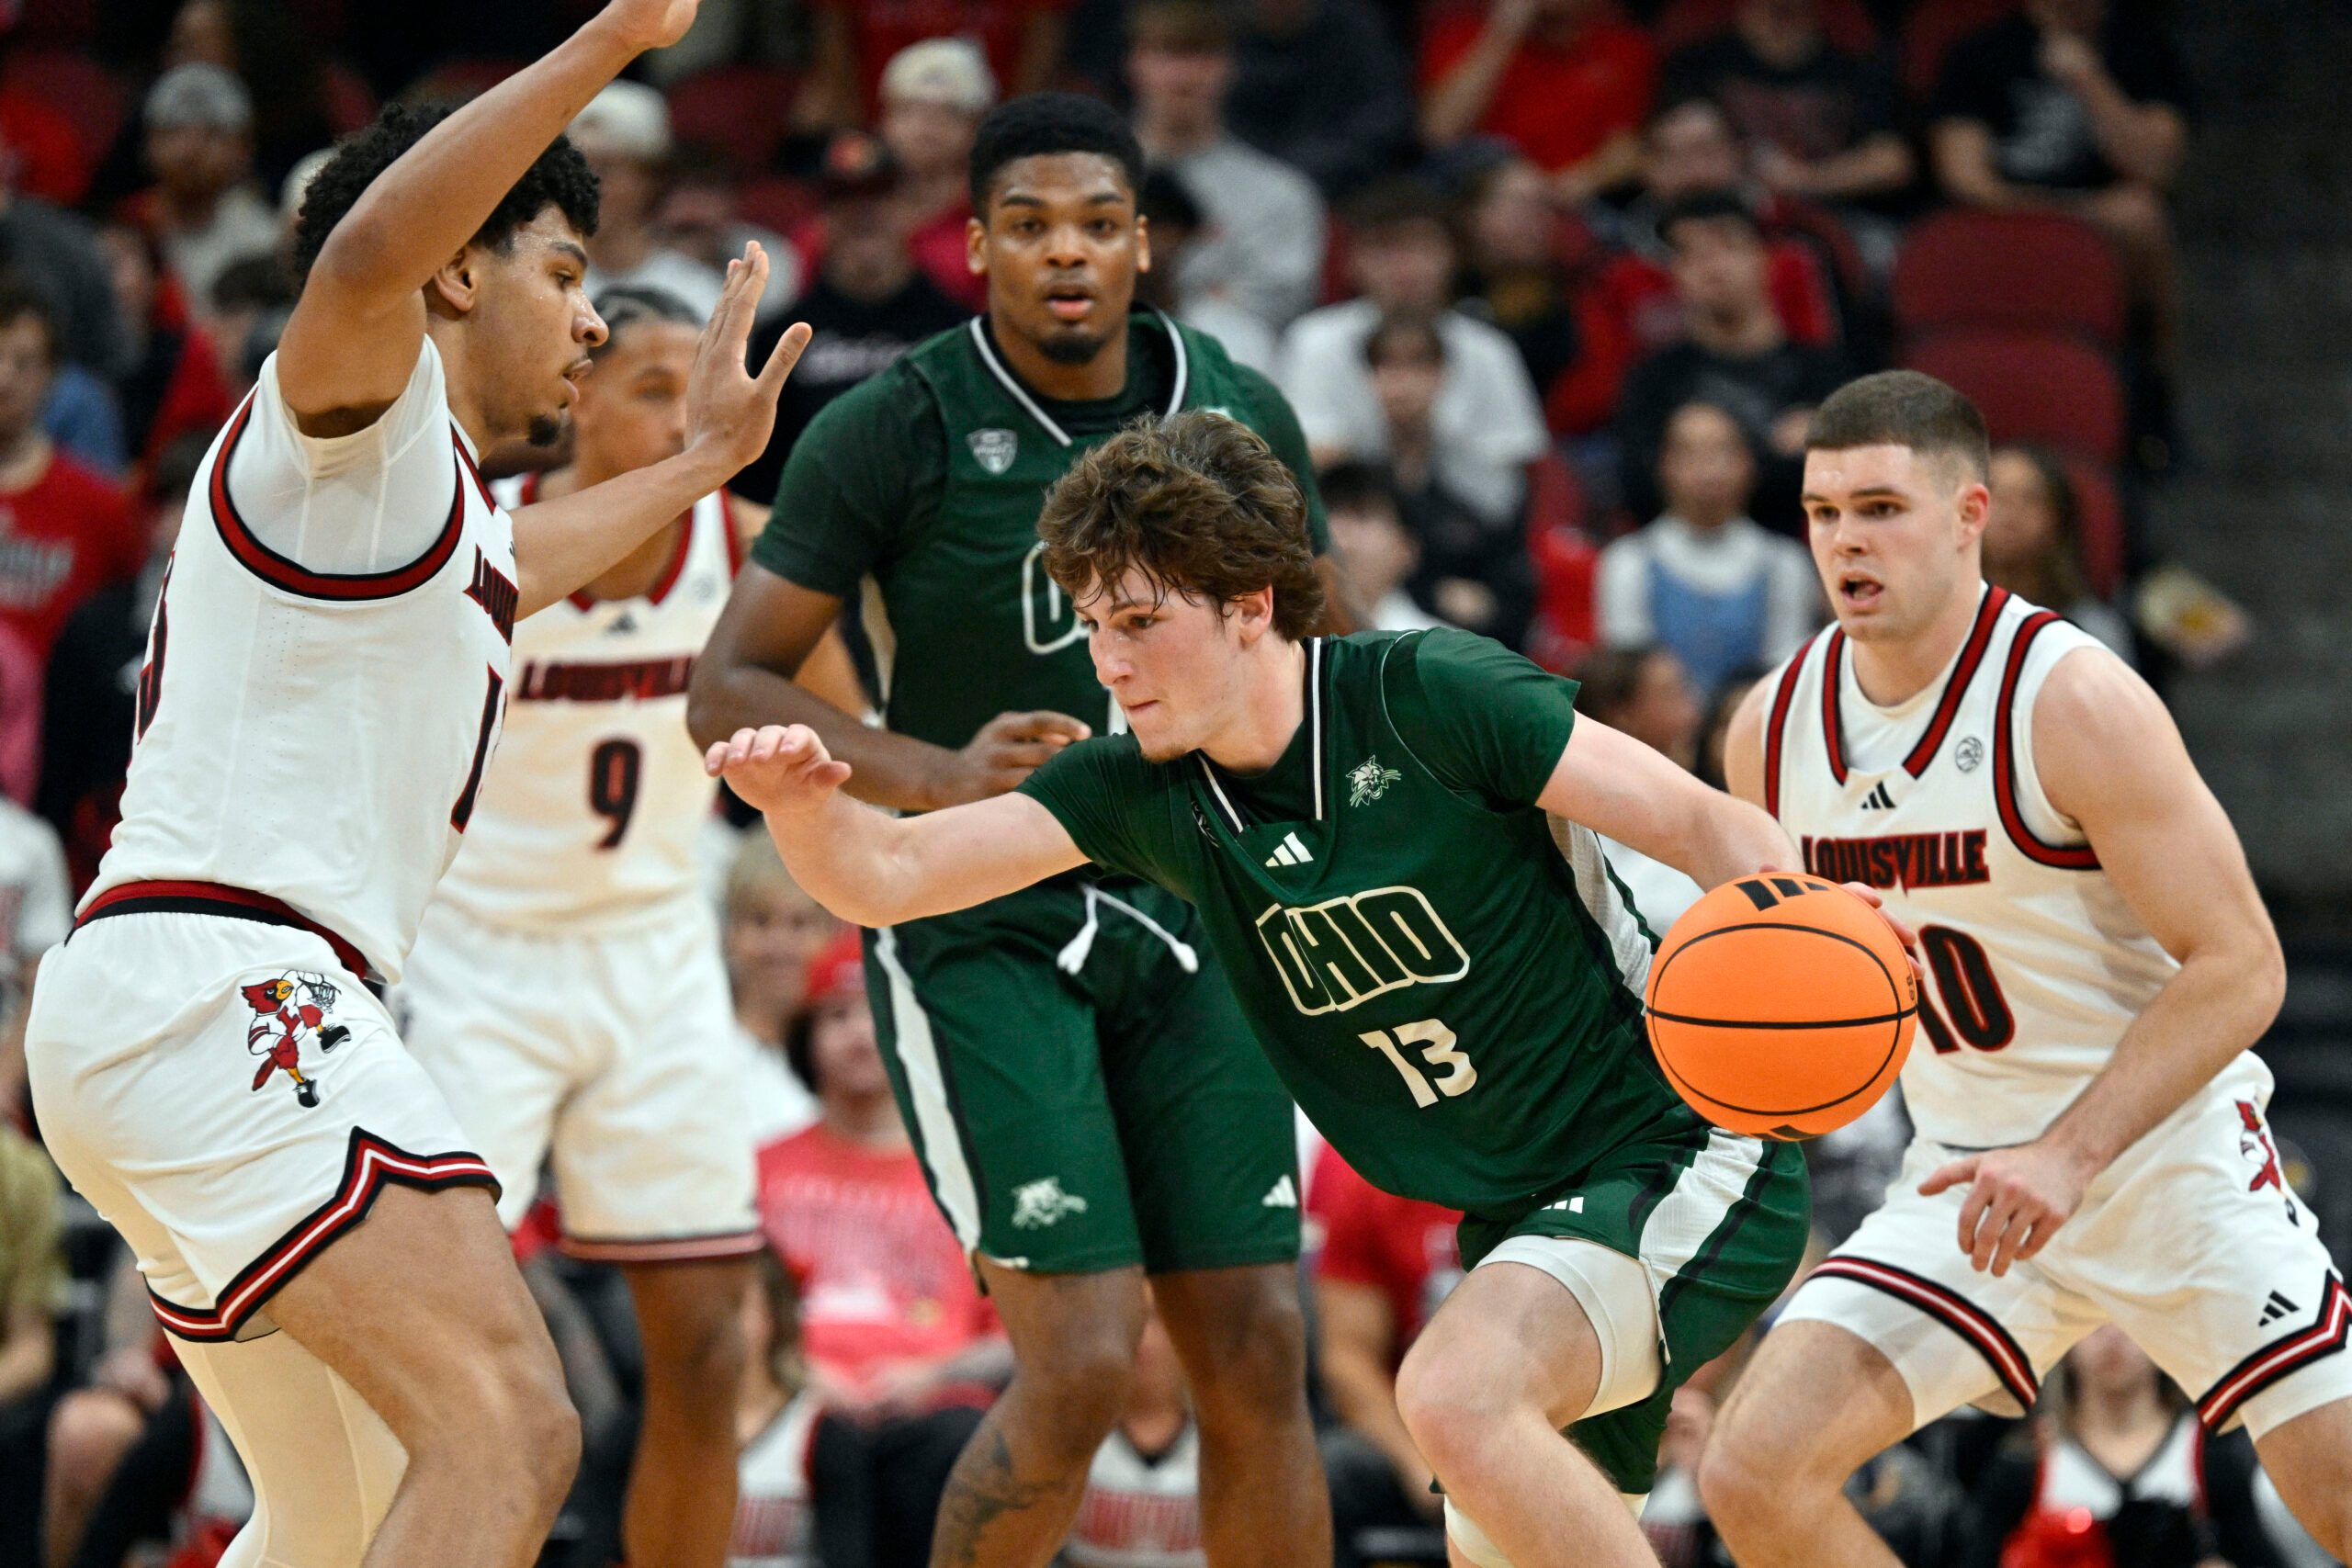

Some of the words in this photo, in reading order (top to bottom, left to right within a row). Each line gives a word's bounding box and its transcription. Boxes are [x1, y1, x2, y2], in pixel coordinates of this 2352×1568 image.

[591, 738, 641, 851] 9
[1801, 829, 1991, 897] LOUISVILLE
[1255, 886, 1471, 1016] OHIO
[1357, 1018, 1477, 1109] 13
